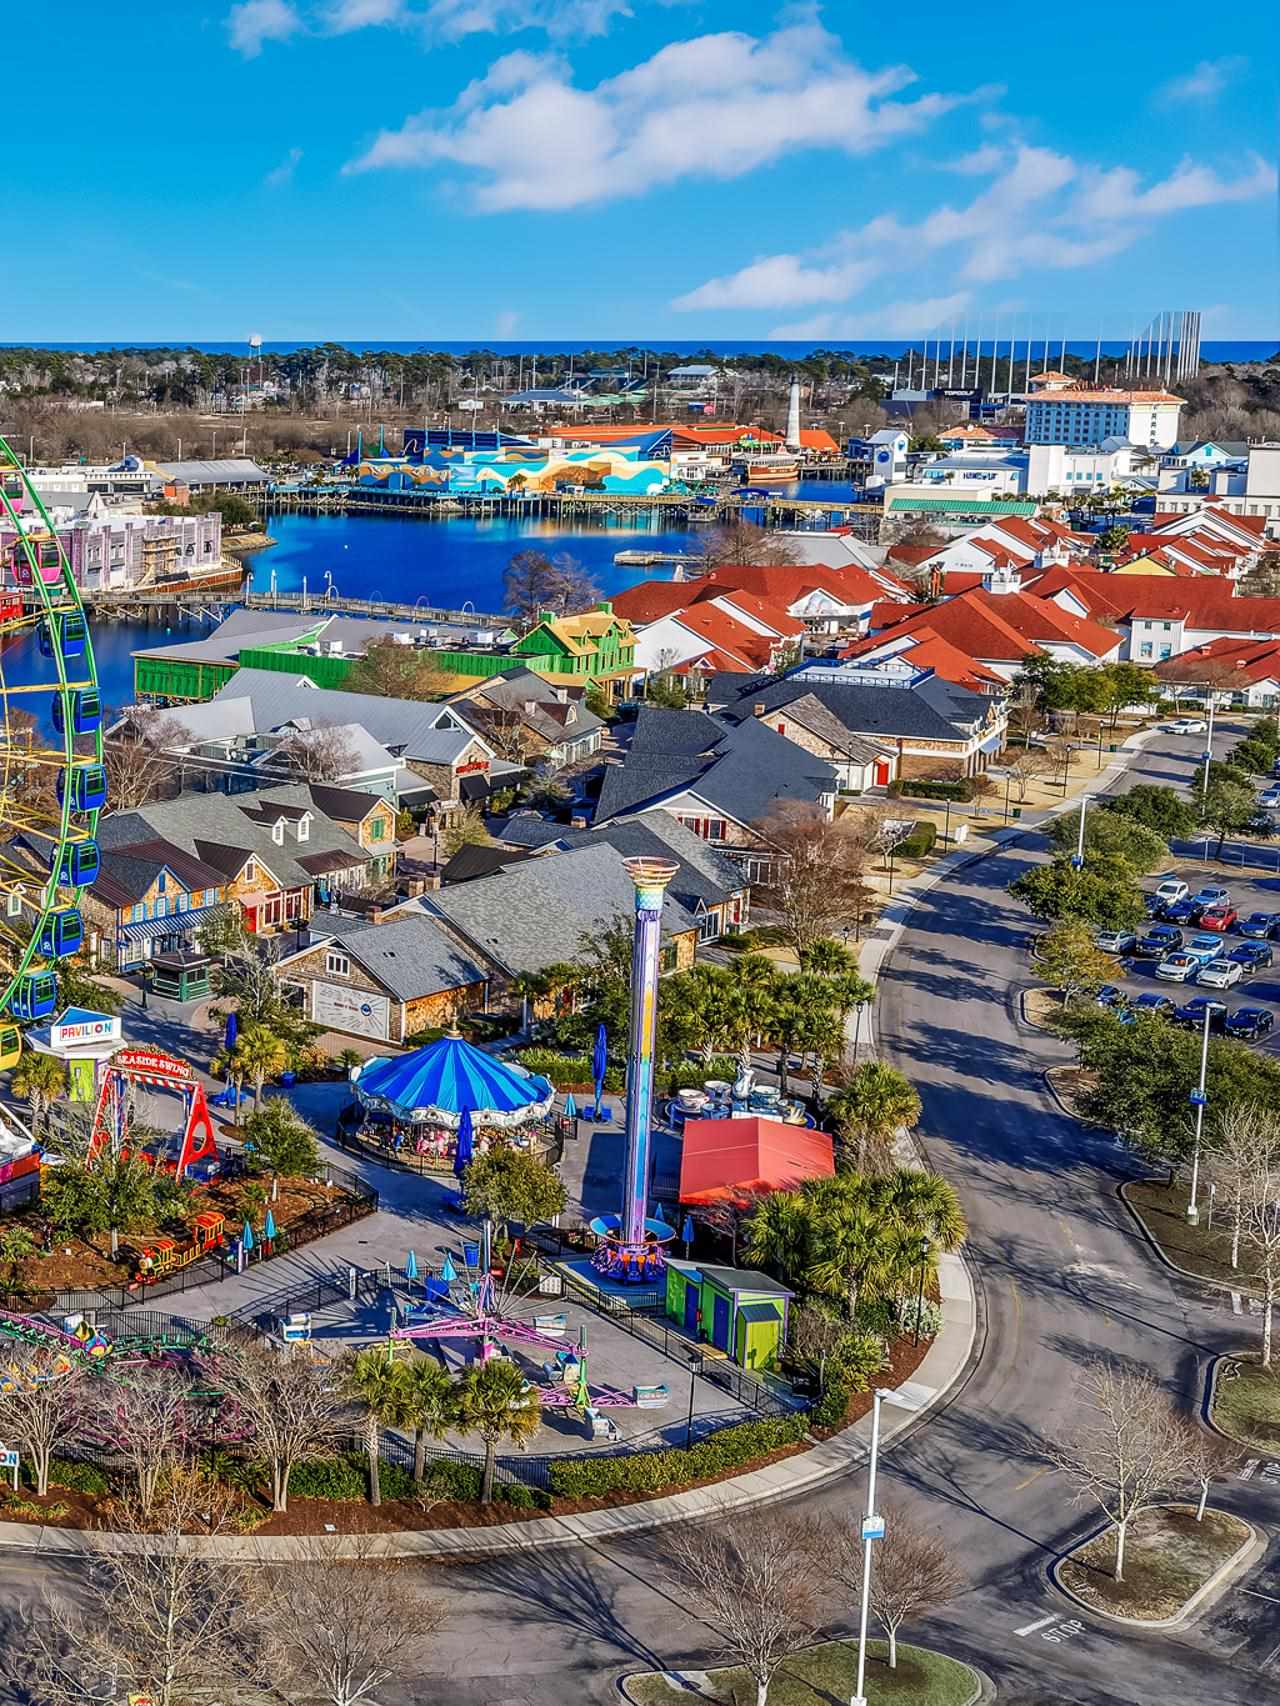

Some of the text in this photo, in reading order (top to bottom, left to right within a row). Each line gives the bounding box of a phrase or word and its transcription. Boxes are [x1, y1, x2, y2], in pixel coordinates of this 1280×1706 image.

[61, 1022, 113, 1039] PAVILION
[116, 1055, 190, 1077] SEASIDE SWING
[1041, 1619, 1087, 1643] STOP
